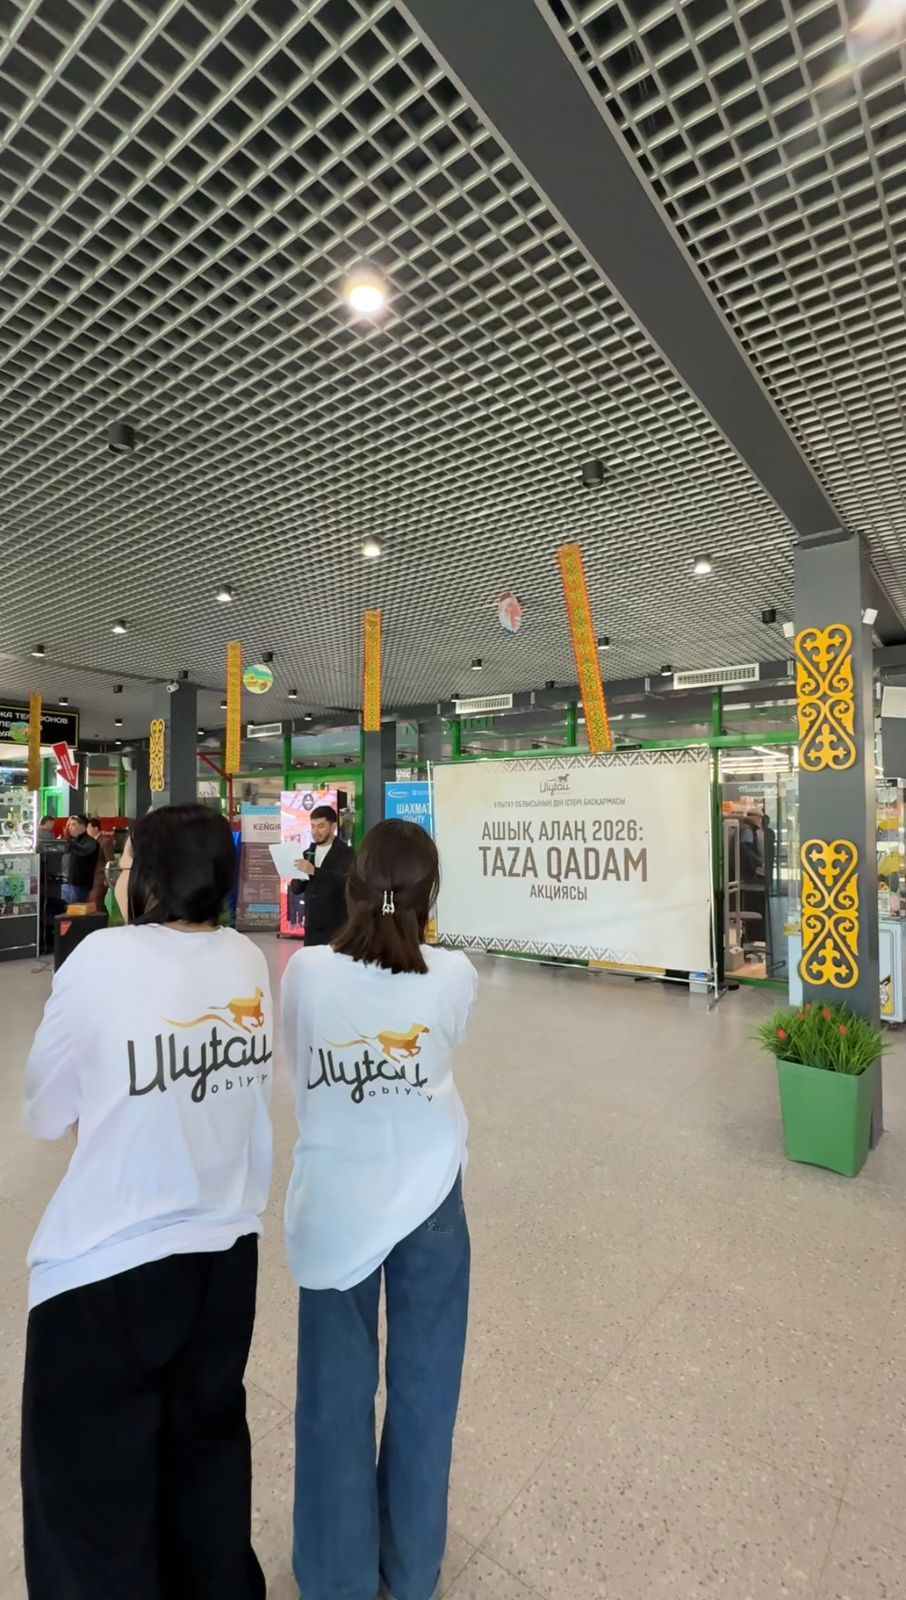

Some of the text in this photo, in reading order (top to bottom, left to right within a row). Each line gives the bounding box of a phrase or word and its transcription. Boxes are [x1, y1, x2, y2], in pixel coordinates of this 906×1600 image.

[14, 712, 69, 724] ТЕОНОВ
[539, 782, 570, 796] Ulytau
[481, 819, 644, 843] АШЫҚ АЛАҢ 2026:
[478, 846, 647, 883] TAZA QADAM
[530, 884, 588, 901] АКЦИЯСЫ
[127, 1026, 273, 1103] Ulytau
[211, 1074, 268, 1094] oblyy
[368, 1086, 433, 1102] oblyy
